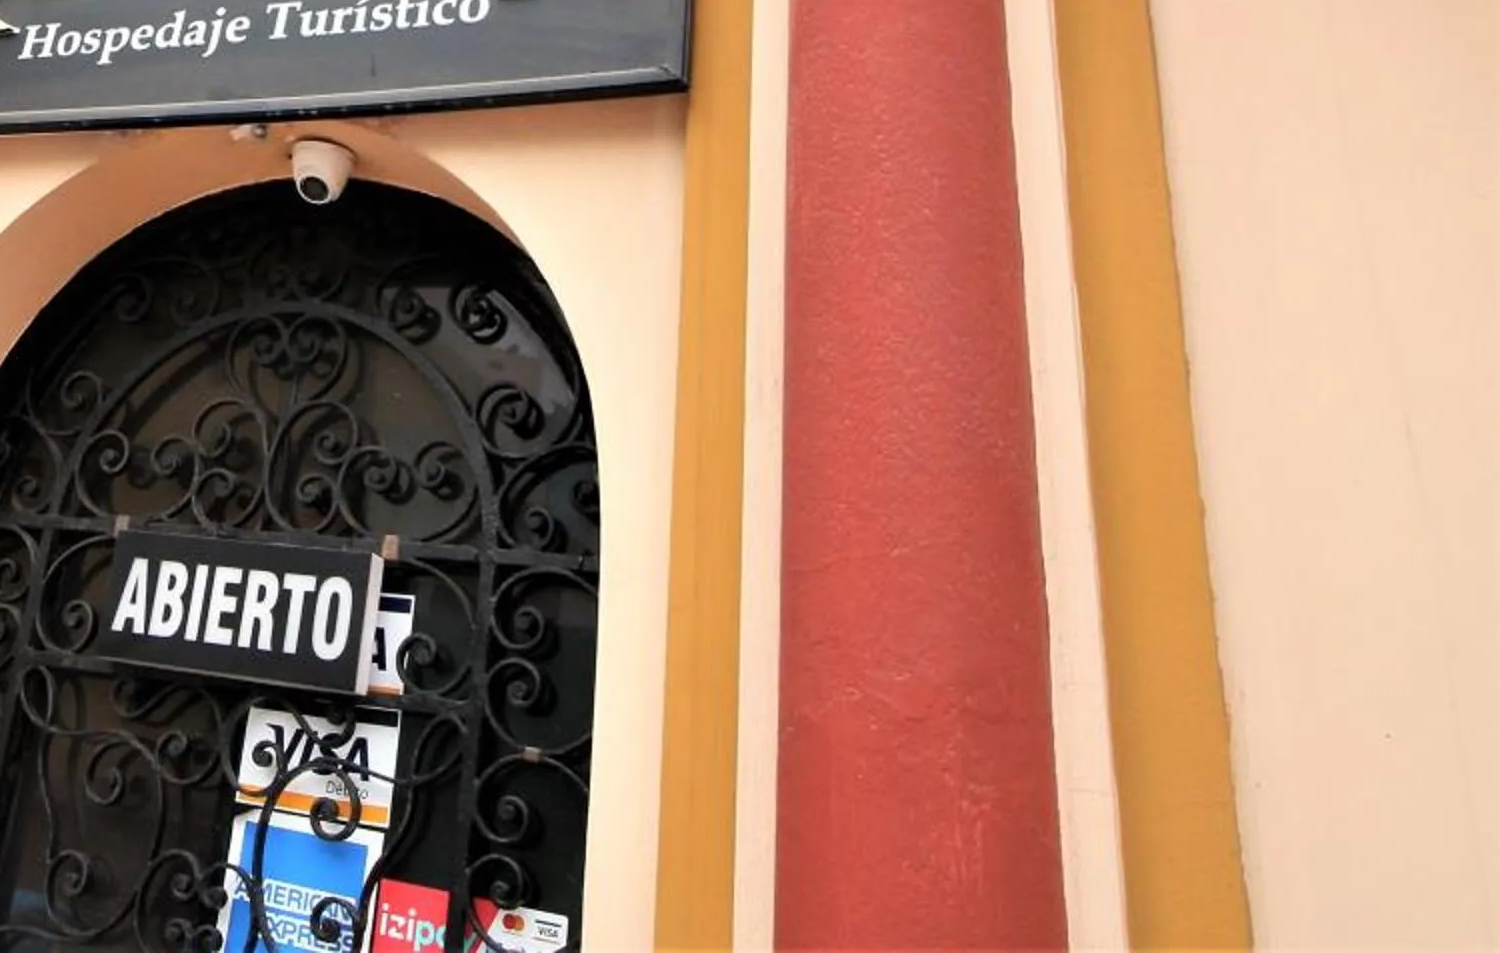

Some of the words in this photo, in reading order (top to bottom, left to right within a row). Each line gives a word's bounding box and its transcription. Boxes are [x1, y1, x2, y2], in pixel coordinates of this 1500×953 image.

[17, 7, 250, 66] Hospedaje
[111, 557, 354, 661] ABIERTO
[266, 722, 370, 782] VIA
[379, 902, 479, 953] izip
